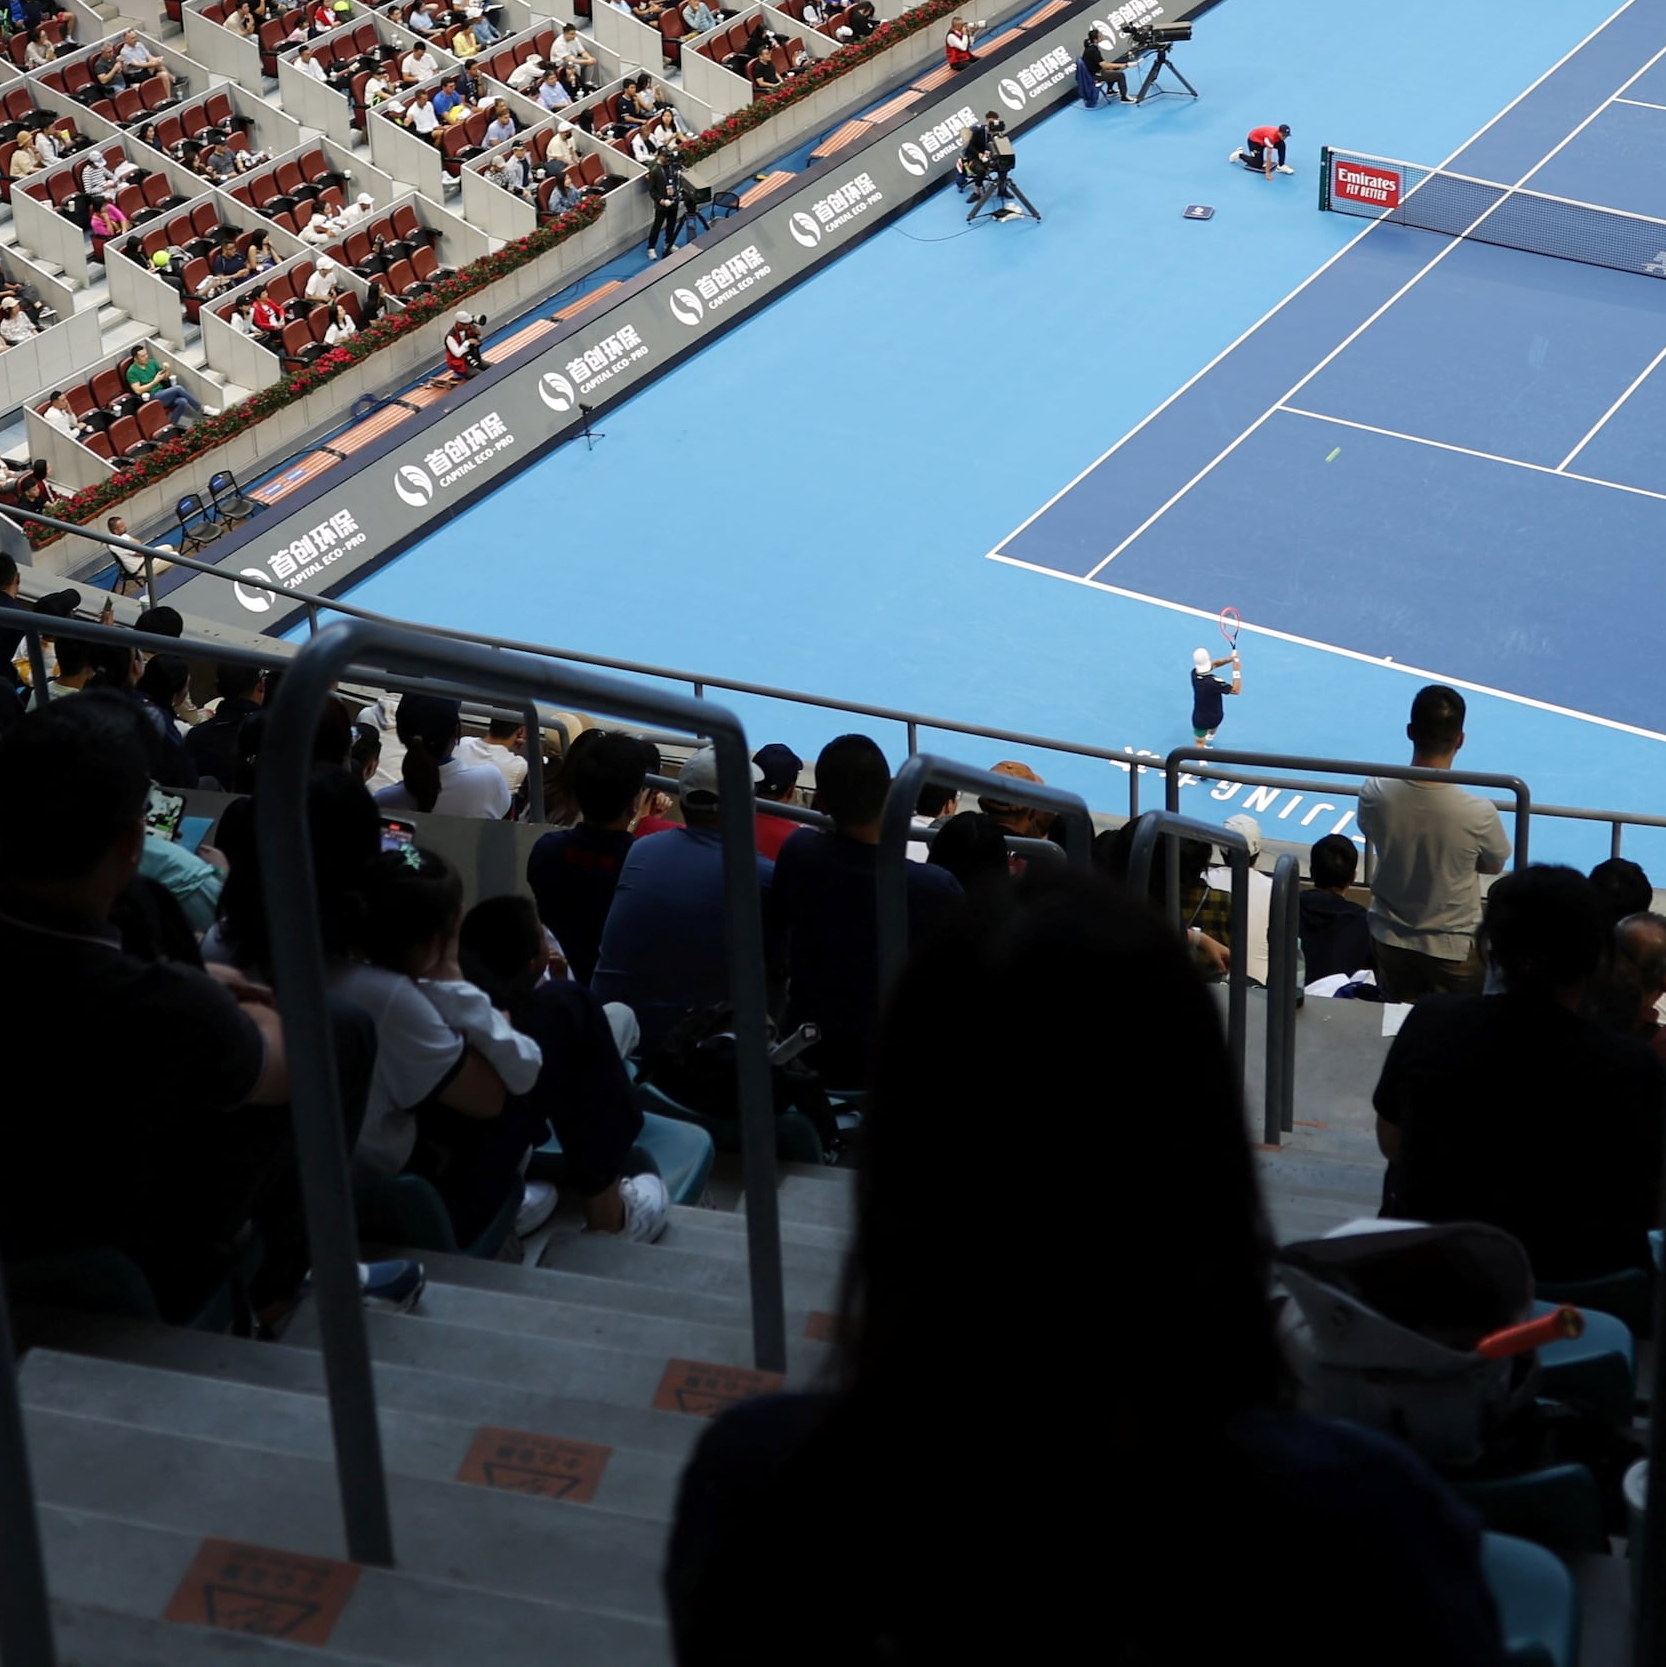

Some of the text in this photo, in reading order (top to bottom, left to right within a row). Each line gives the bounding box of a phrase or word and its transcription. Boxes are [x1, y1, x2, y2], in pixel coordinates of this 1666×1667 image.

[1016, 45, 1073, 90] 首创环保
[811, 172, 877, 225] 首创环保
[1337, 167, 1398, 192] Emirates
[1345, 184, 1389, 202] FLY BETTER
[694, 245, 766, 301] 首创环保
[565, 323, 643, 385] 首创环保
[423, 410, 508, 478] 首创环保
[266, 508, 361, 580] 首创环保
